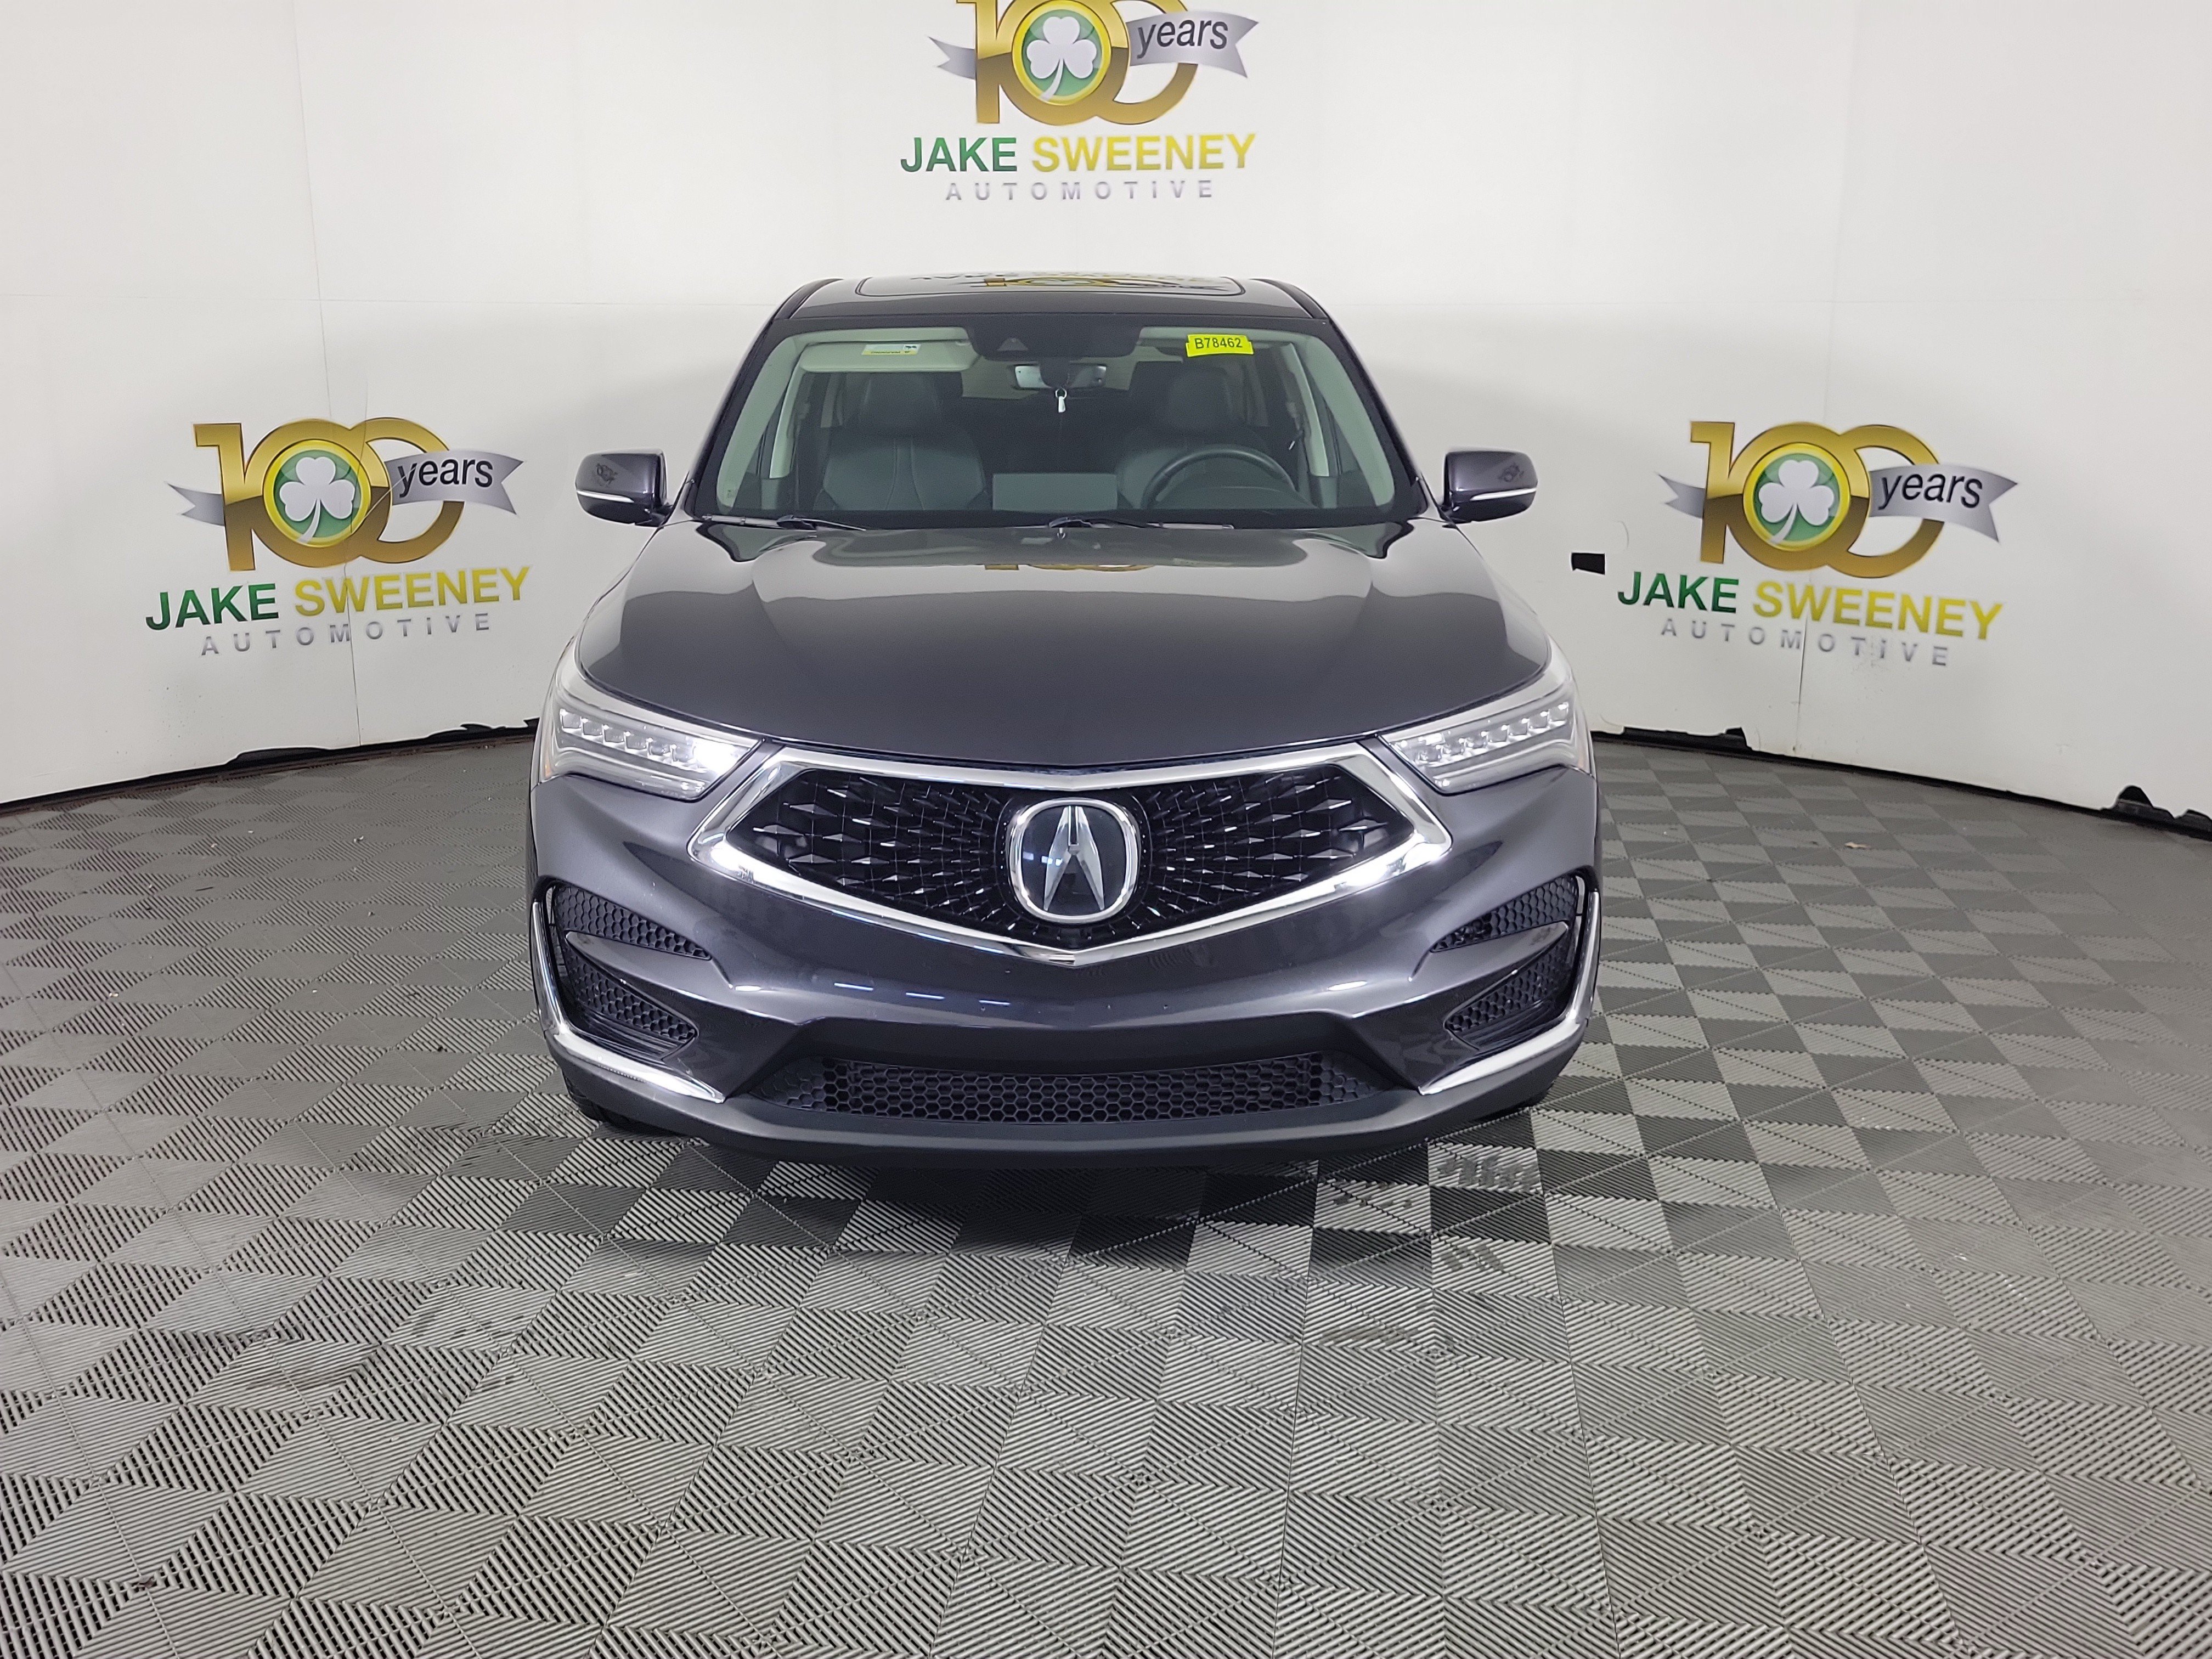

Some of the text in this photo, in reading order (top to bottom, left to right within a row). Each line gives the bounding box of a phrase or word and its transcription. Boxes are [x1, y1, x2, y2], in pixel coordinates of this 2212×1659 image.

[1136, 19, 1229, 59] years
[900, 133, 1256, 173] JAKE SWEENEY
[946, 179, 1214, 201] AUTOMOTIVE
[1194, 337, 1243, 349] B78462
[398, 456, 494, 498] years
[1878, 472, 1984, 510] years
[145, 566, 531, 631] JAKE SWEENEY
[1618, 571, 2005, 641] JAKE SWEENEY
[201, 612, 491, 656] AUTOMOTIVE
[1661, 617, 1949, 667] AUTOMOTIVE
